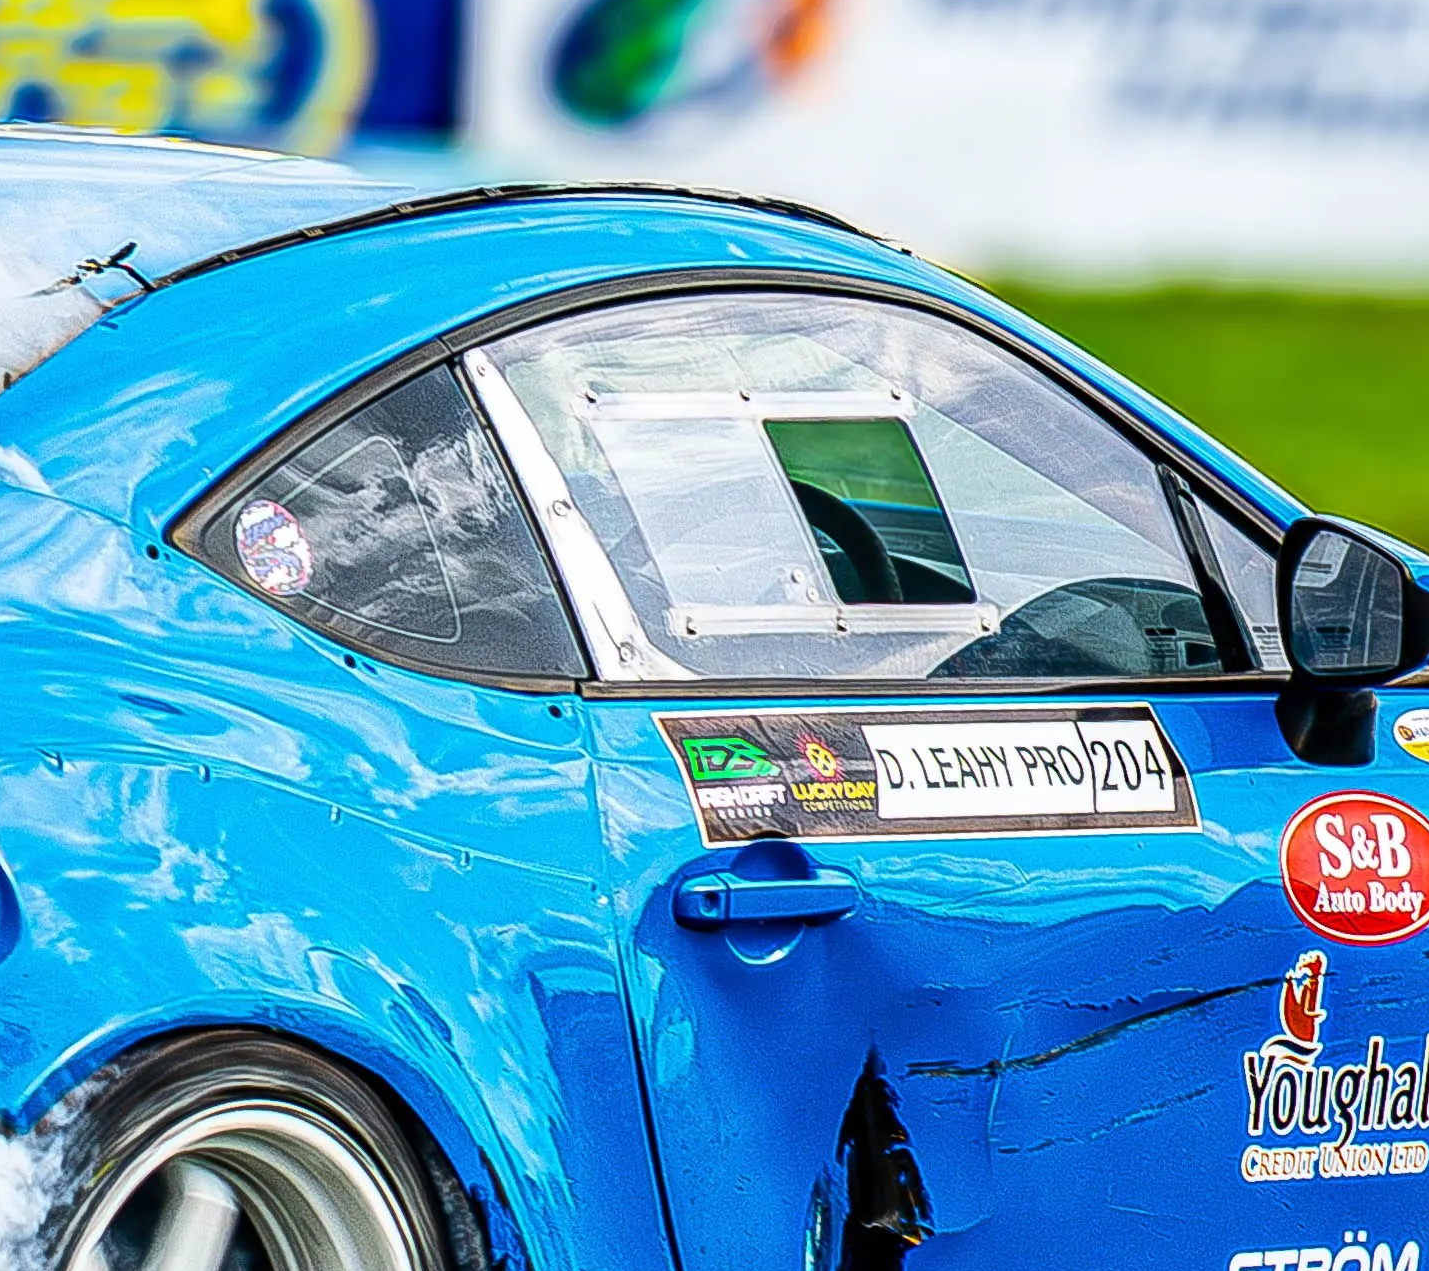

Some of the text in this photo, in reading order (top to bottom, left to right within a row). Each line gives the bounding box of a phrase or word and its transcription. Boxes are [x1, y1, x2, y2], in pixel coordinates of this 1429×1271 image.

[876, 739, 1167, 792] D. LEAHY PRO 204
[843, 781, 877, 799] DAY
[1313, 812, 1413, 880] S&B
[1313, 881, 1426, 922] Auto Body
[1243, 1143, 1428, 1178] CREDIT UNION LTD
